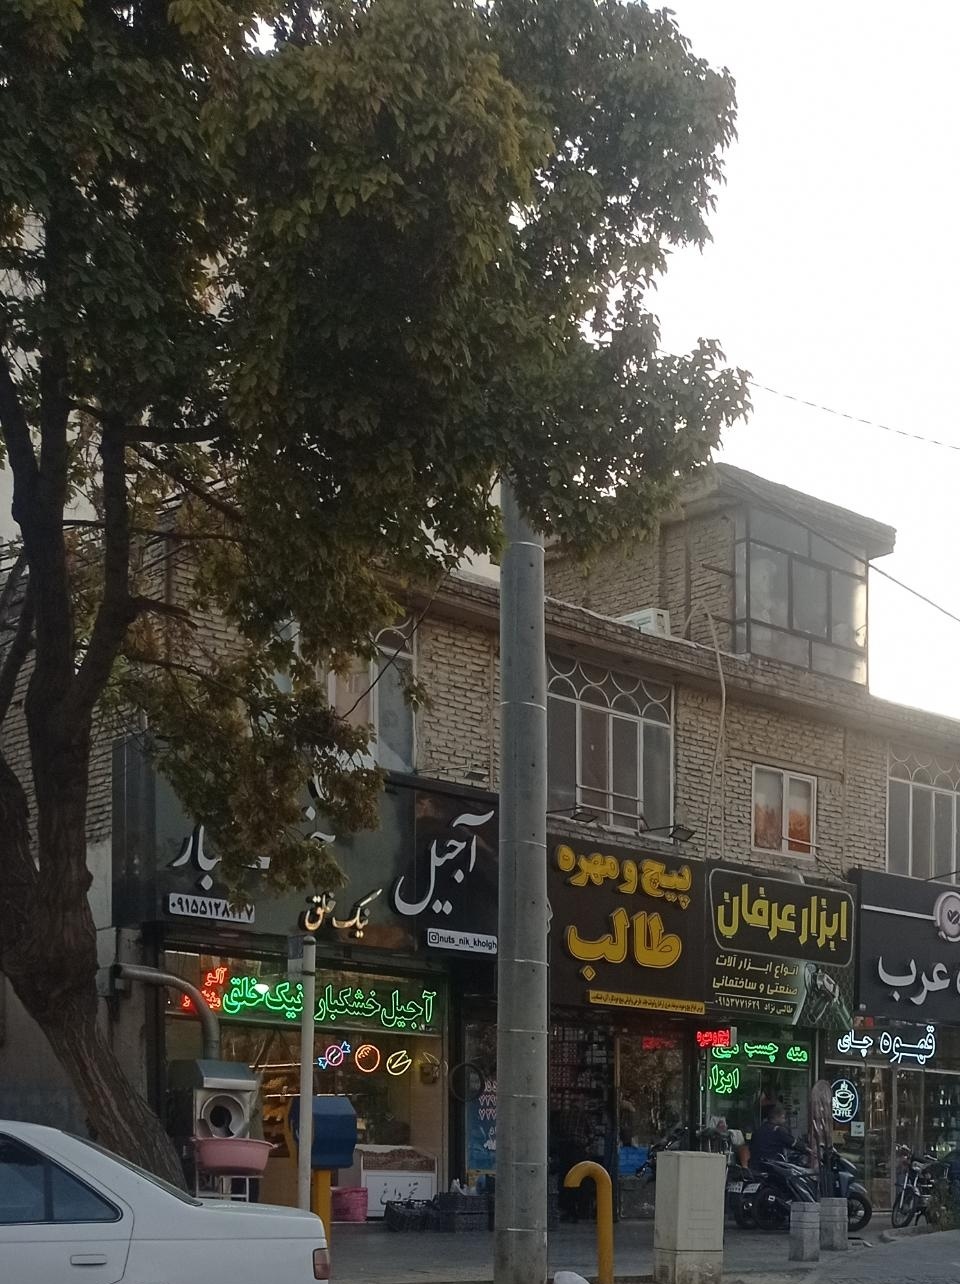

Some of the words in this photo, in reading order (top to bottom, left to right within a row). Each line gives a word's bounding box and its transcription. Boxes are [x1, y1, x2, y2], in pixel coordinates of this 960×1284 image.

[394, 810, 495, 916] آجیل
[557, 845, 619, 887] مهره
[617, 860, 638, 894] و
[641, 859, 692, 909] پیچ
[717, 883, 796, 941] عرفان
[799, 896, 847, 951] ابزار
[567, 907, 682, 981] طالب
[715, 953, 737, 968] آلات
[712, 975, 757, 990] ساختمانی
[759, 984, 765, 993] و
[766, 982, 799, 996] صنعتی
[774, 963, 799, 979] انواع
[878, 956, 951, 1006] عرب
[265, 982, 304, 1018] نیک
[313, 984, 382, 1021] خشکبار
[381, 989, 437, 1029] آجیل
[837, 1029, 874, 1058] چای
[879, 1025, 936, 1065] قهوه
[708, 1064, 740, 1094] ابزار
